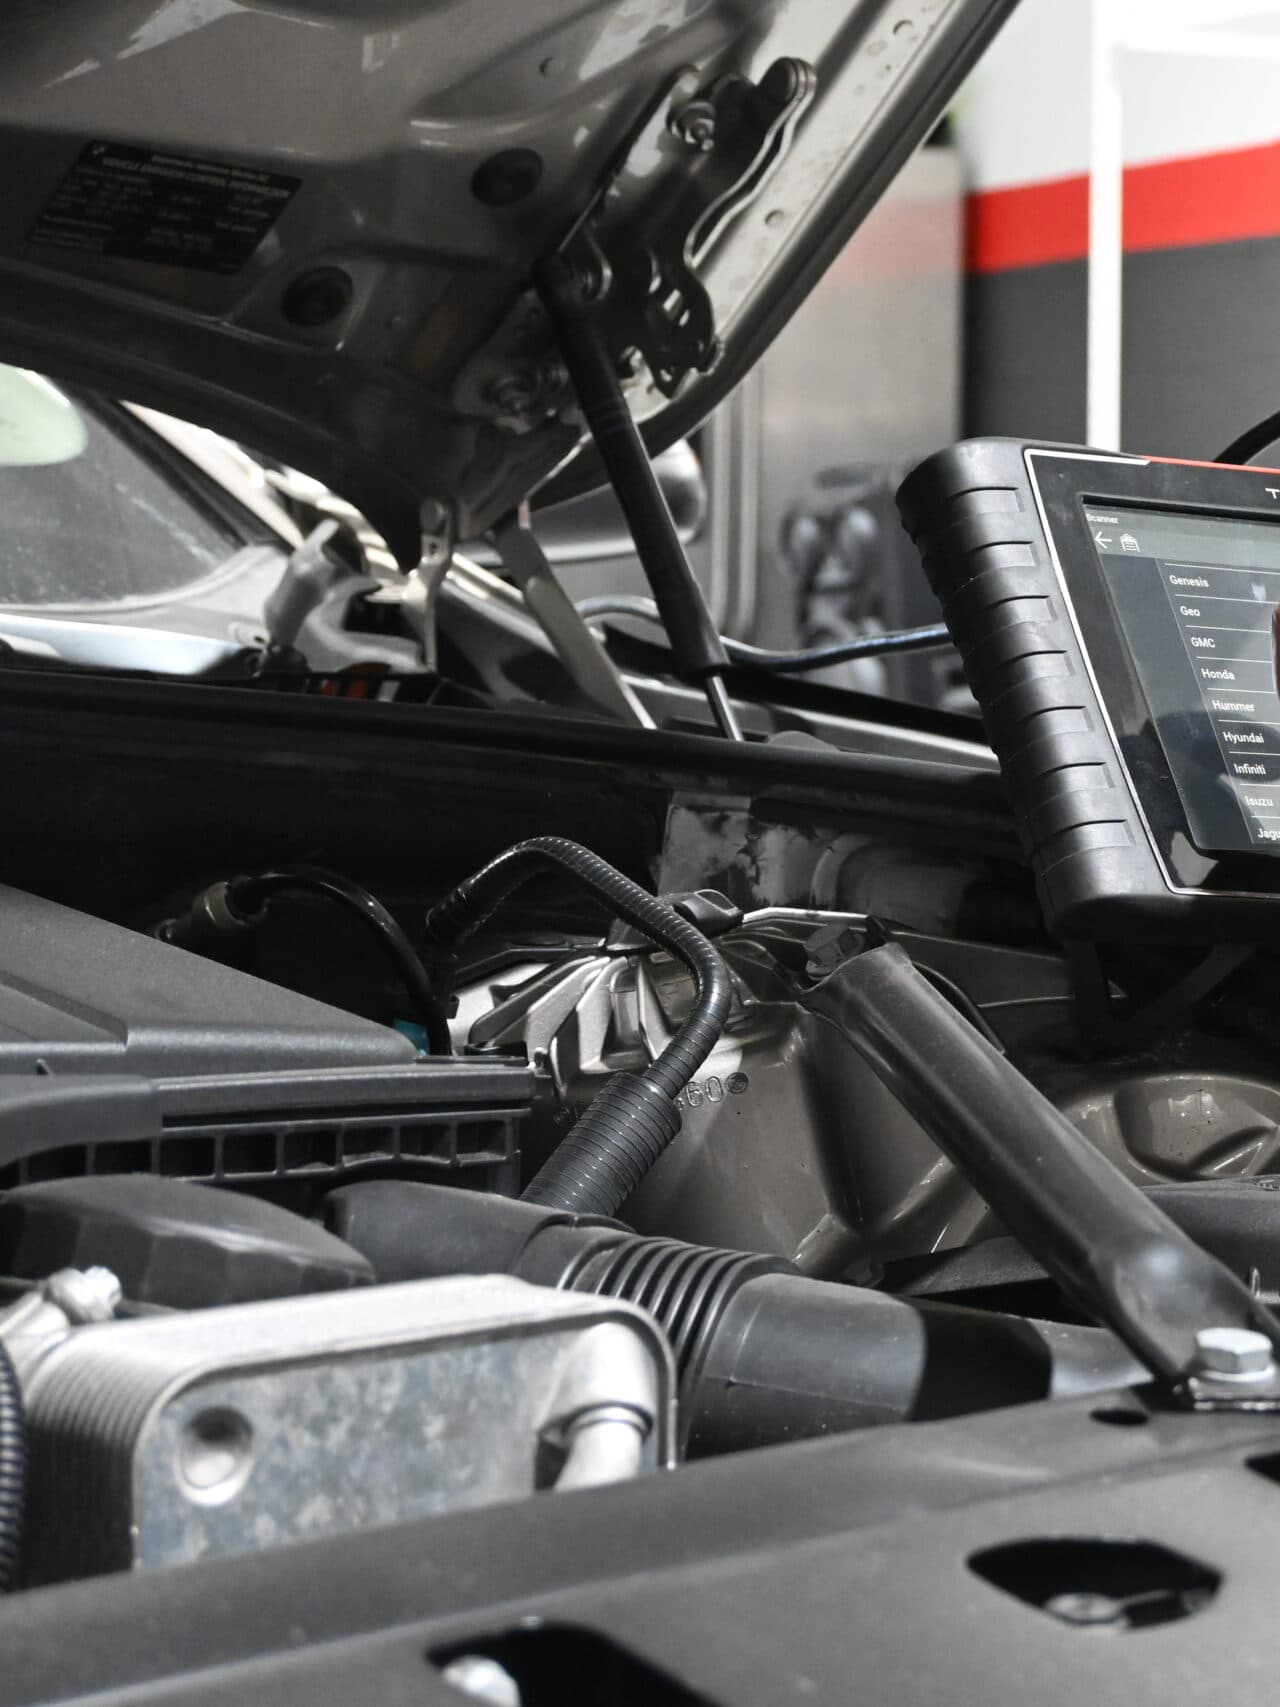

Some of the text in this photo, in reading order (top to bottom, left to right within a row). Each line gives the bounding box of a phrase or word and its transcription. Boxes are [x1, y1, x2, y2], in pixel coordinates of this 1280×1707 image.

[1169, 574, 1209, 588] Genesis
[1180, 605, 1201, 617] Geo
[1190, 636, 1216, 648] GMC
[1201, 668, 1235, 681] Honda
[1212, 700, 1255, 713] Hummer
[1223, 731, 1265, 744] Hyundai
[1233, 763, 1267, 775] Infiniti
[1244, 795, 1274, 807] Isuzu
